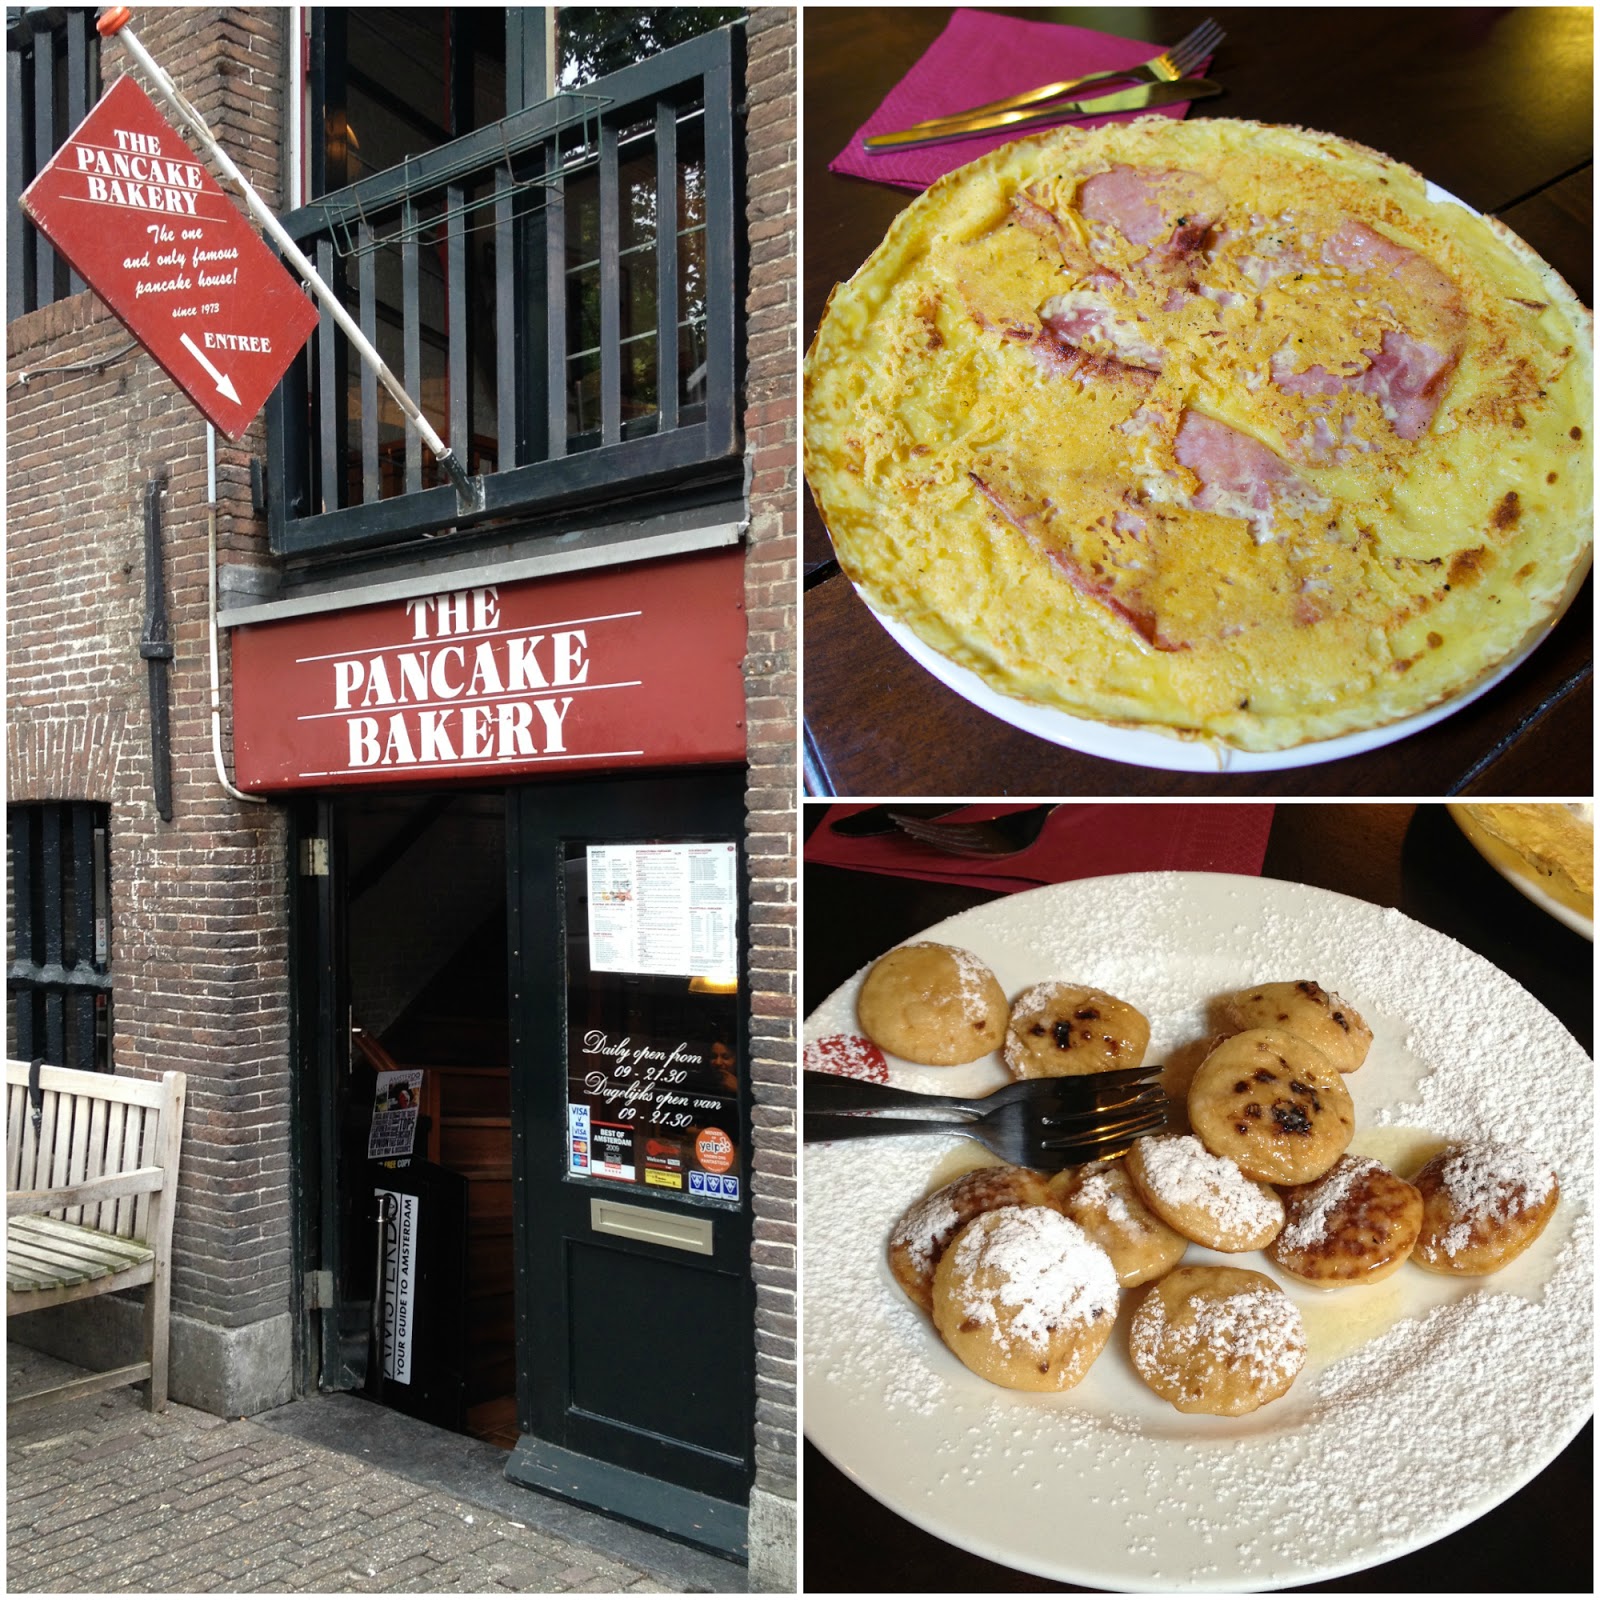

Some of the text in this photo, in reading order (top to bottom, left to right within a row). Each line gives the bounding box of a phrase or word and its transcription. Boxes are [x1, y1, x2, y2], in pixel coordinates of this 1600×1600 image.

[114, 129, 161, 156] THE
[76, 147, 203, 189] PANCAKE
[87, 176, 199, 215] BAKERY
[147, 225, 203, 244] The one
[123, 247, 239, 270] and only famous
[135, 268, 238, 298] pancake house!
[172, 303, 220, 318] since 1973
[203, 332, 272, 353] ENTREE
[406, 586, 501, 640] THE
[333, 629, 590, 711] PANCAKE
[347, 697, 574, 767] BAKERY
[582, 1029, 703, 1068] Daily open from
[614, 1065, 632, 1078] 09
[643, 1067, 687, 1084] 21.30
[584, 1070, 722, 1110] Dagelijks open van
[572, 1107, 588, 1116] VISA
[618, 1108, 637, 1120] 09
[649, 1110, 693, 1128] 21.30
[594, 1135, 632, 1147] AMSTERDAM
[600, 1129, 616, 1137] BEST
[606, 1144, 620, 1152] 2009
[699, 1140, 721, 1153] yelp
[384, 1159, 411, 1169] FREE COPY
[397, 1199, 412, 1376] YOUR GUIDE TO AMSTERDAM
